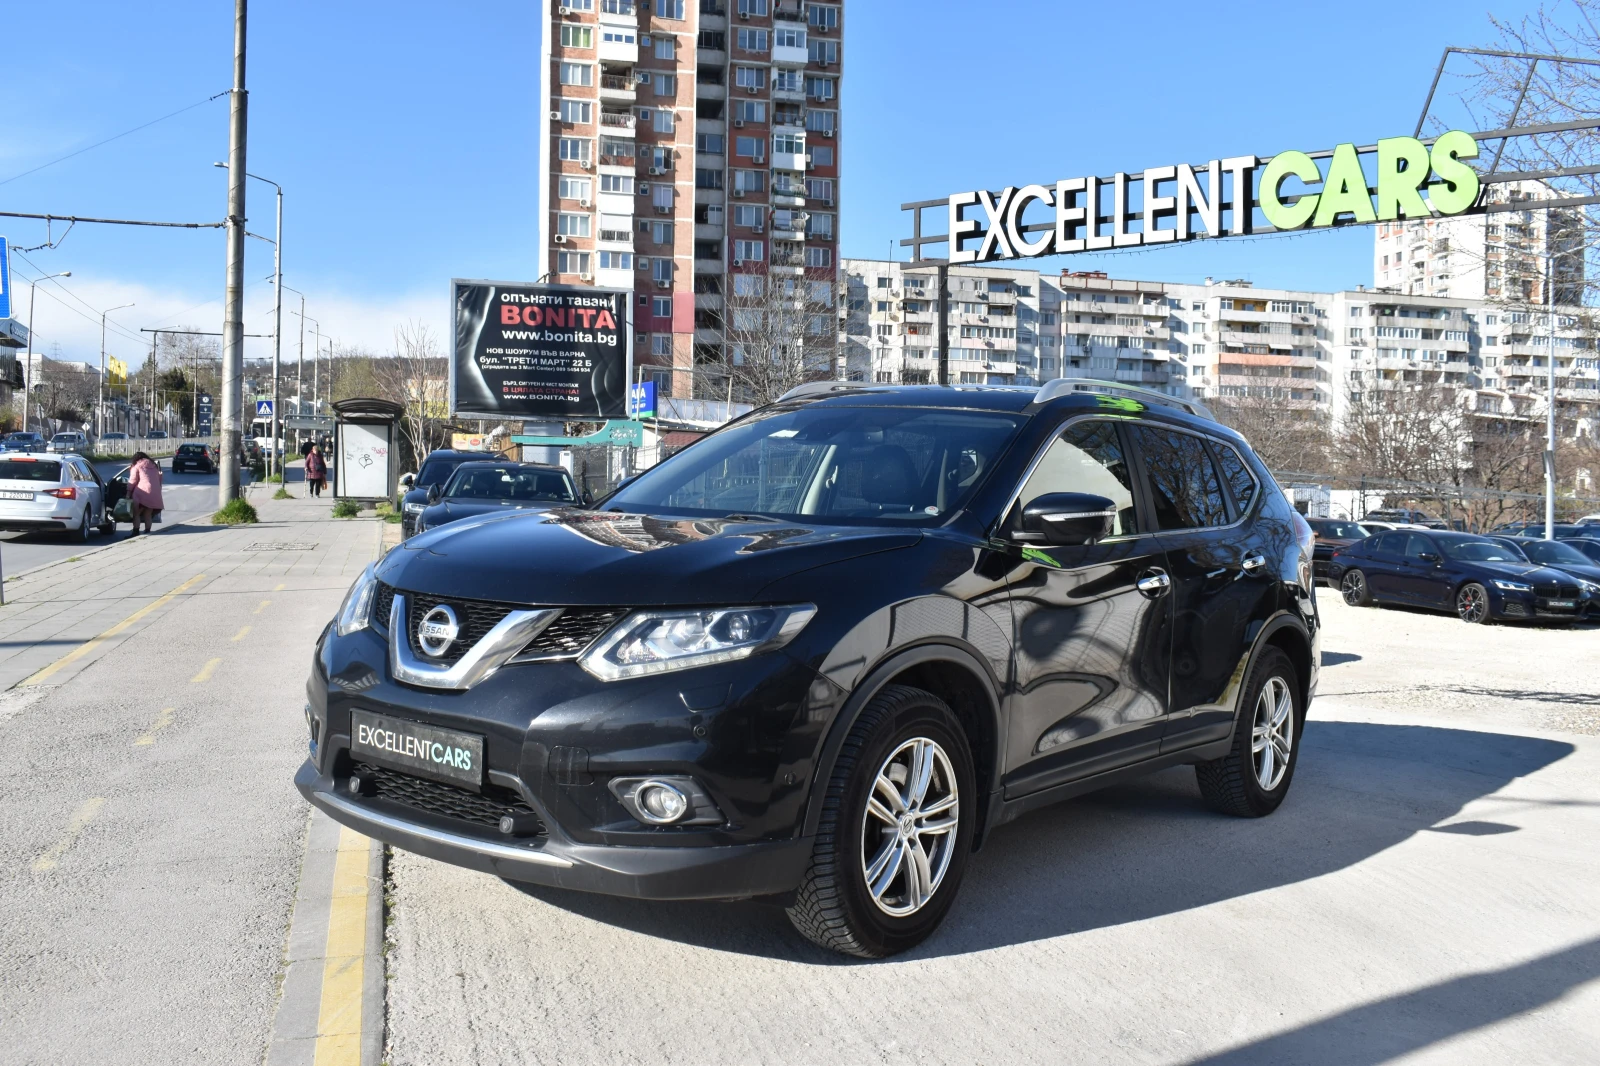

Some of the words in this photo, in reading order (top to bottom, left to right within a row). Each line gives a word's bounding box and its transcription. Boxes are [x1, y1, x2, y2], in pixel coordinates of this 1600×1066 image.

[501, 293, 562, 305] опънати
[567, 296, 614, 307] тавани
[501, 304, 616, 330] BONITA
[502, 330, 617, 346] www.bonita.bg
[480, 356, 500, 364] бул.
[503, 394, 580, 402] www.BONITA.bg
[359, 724, 471, 771] EXCELLENTCARS
